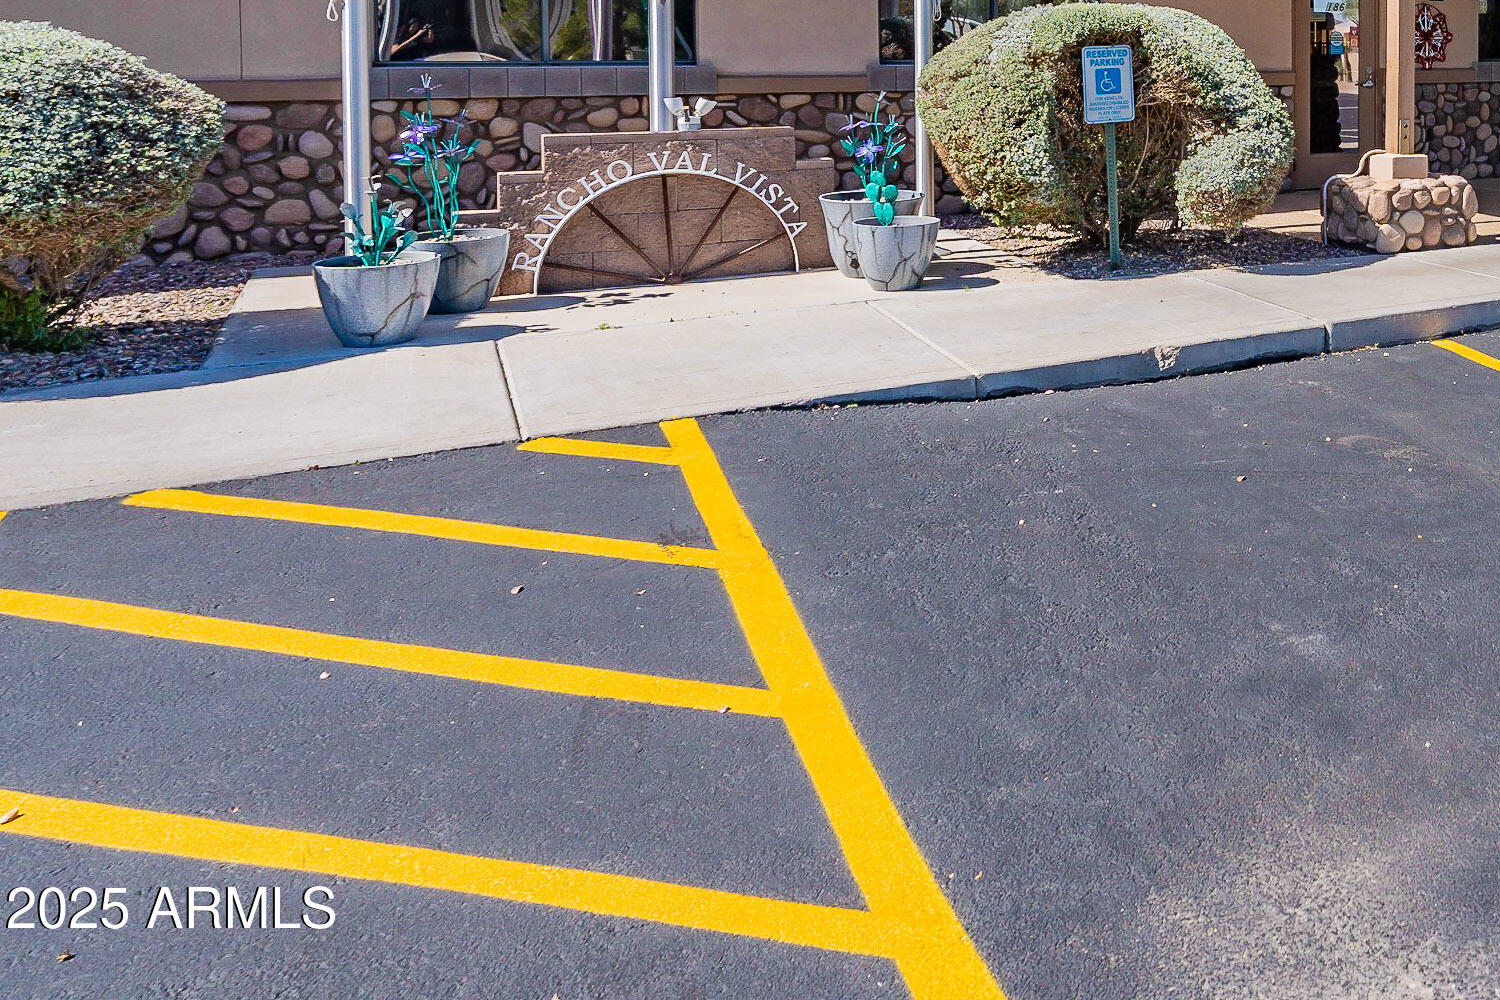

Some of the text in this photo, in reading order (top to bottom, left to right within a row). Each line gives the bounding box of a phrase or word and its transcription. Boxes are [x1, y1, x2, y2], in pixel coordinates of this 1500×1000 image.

[1326, 1, 1346, 12] 186
[1086, 49, 1128, 58] RESERVED
[1090, 57, 1125, 67] PARKING
[511, 150, 809, 273] RANCHO VAL VISTA
